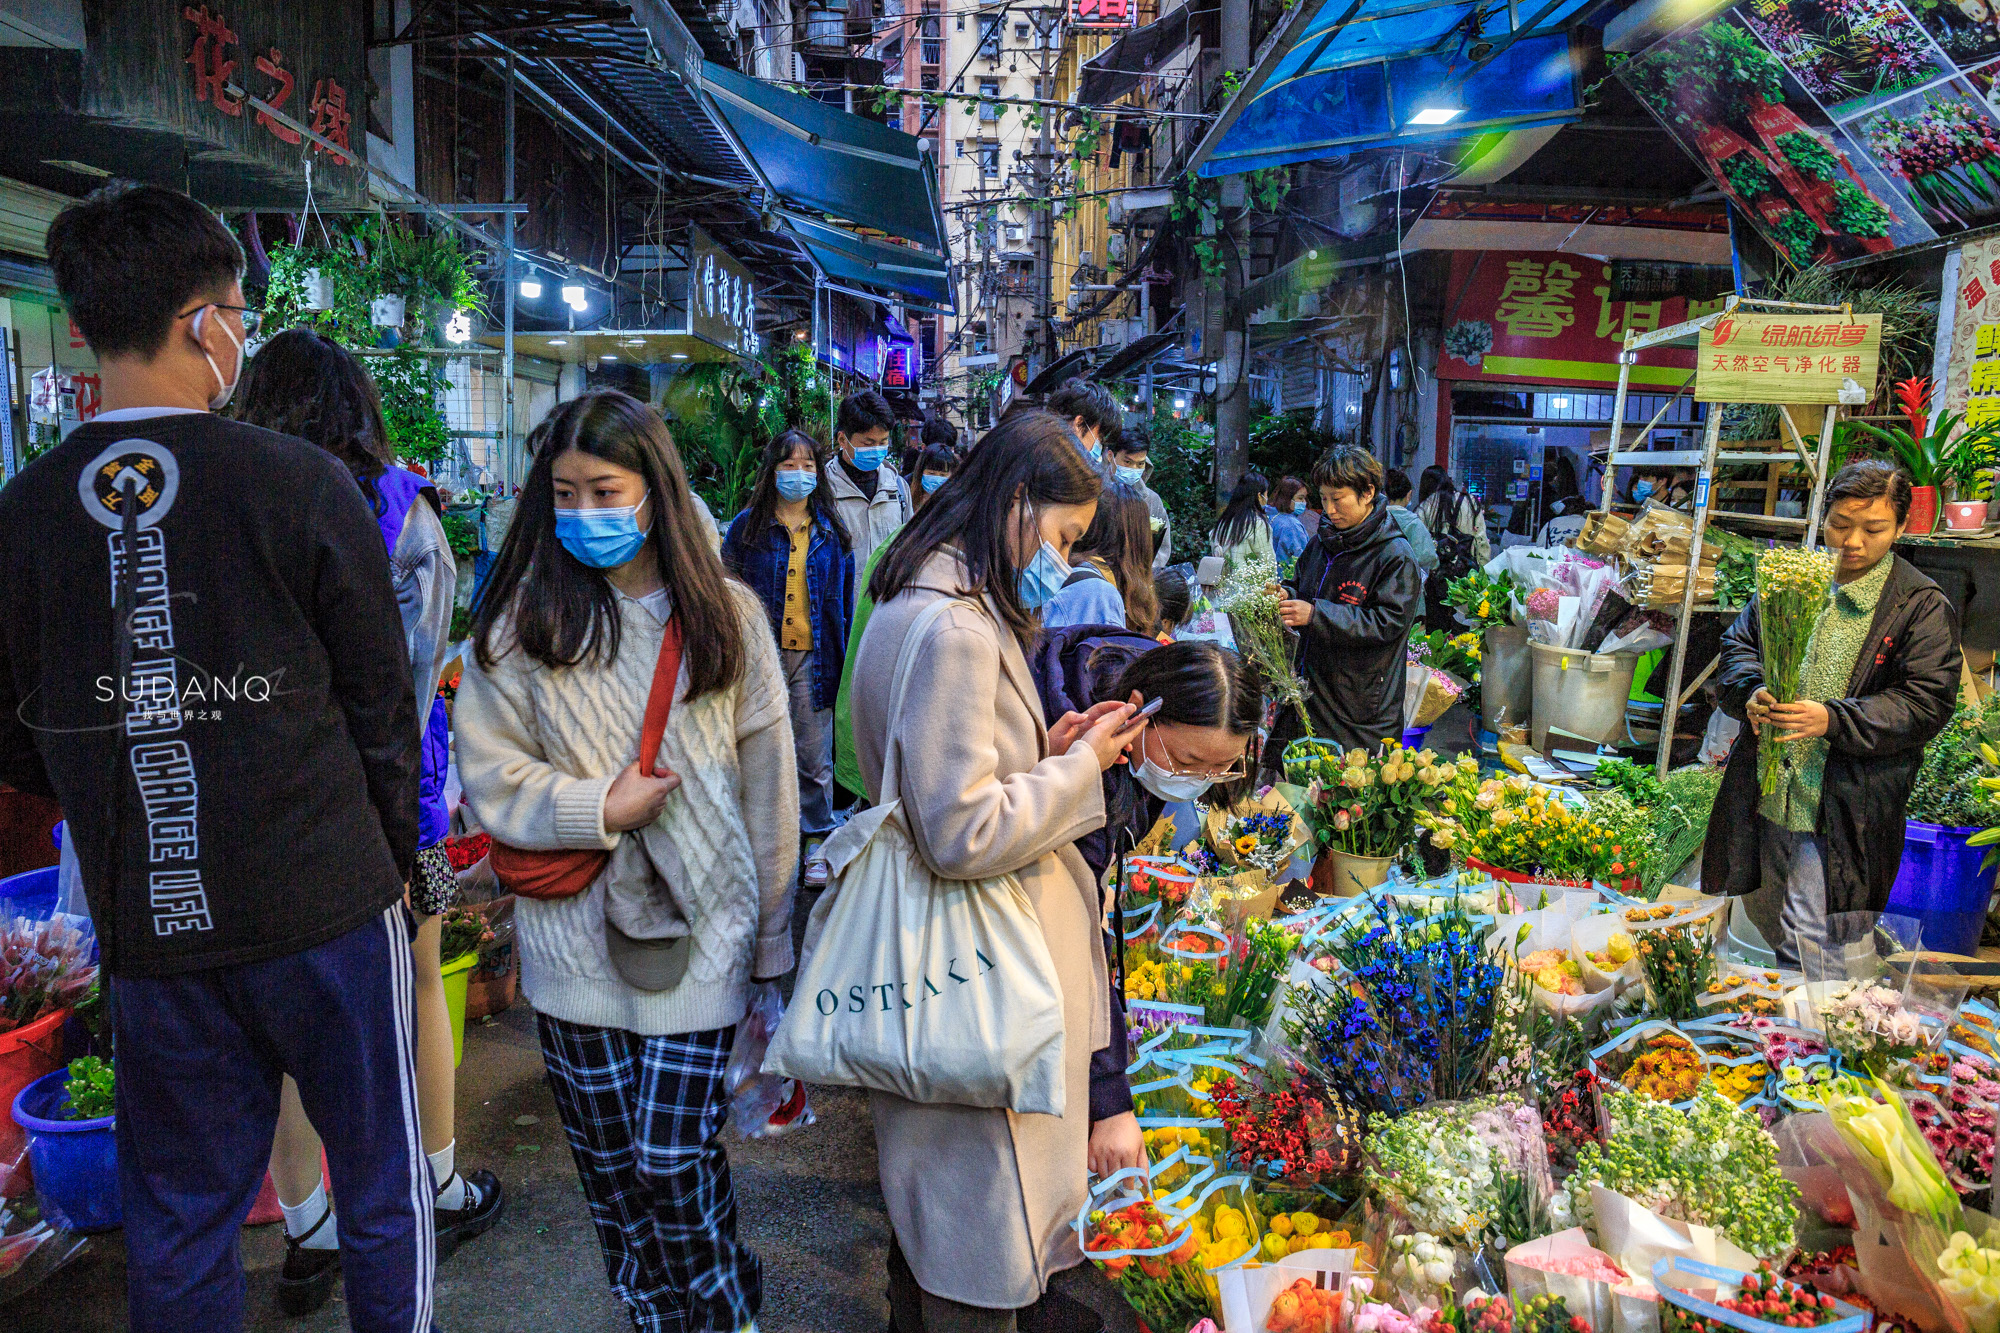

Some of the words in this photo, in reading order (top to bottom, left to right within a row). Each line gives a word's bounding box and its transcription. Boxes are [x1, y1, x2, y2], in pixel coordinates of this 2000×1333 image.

[182, 4, 352, 166] 花之缘
[1711, 354, 1861, 374] 天然空气净化器
[1760, 324, 1869, 348] 绿航绿萝
[130, 740, 199, 862] CHANGE
[149, 869, 214, 937] LIFE
